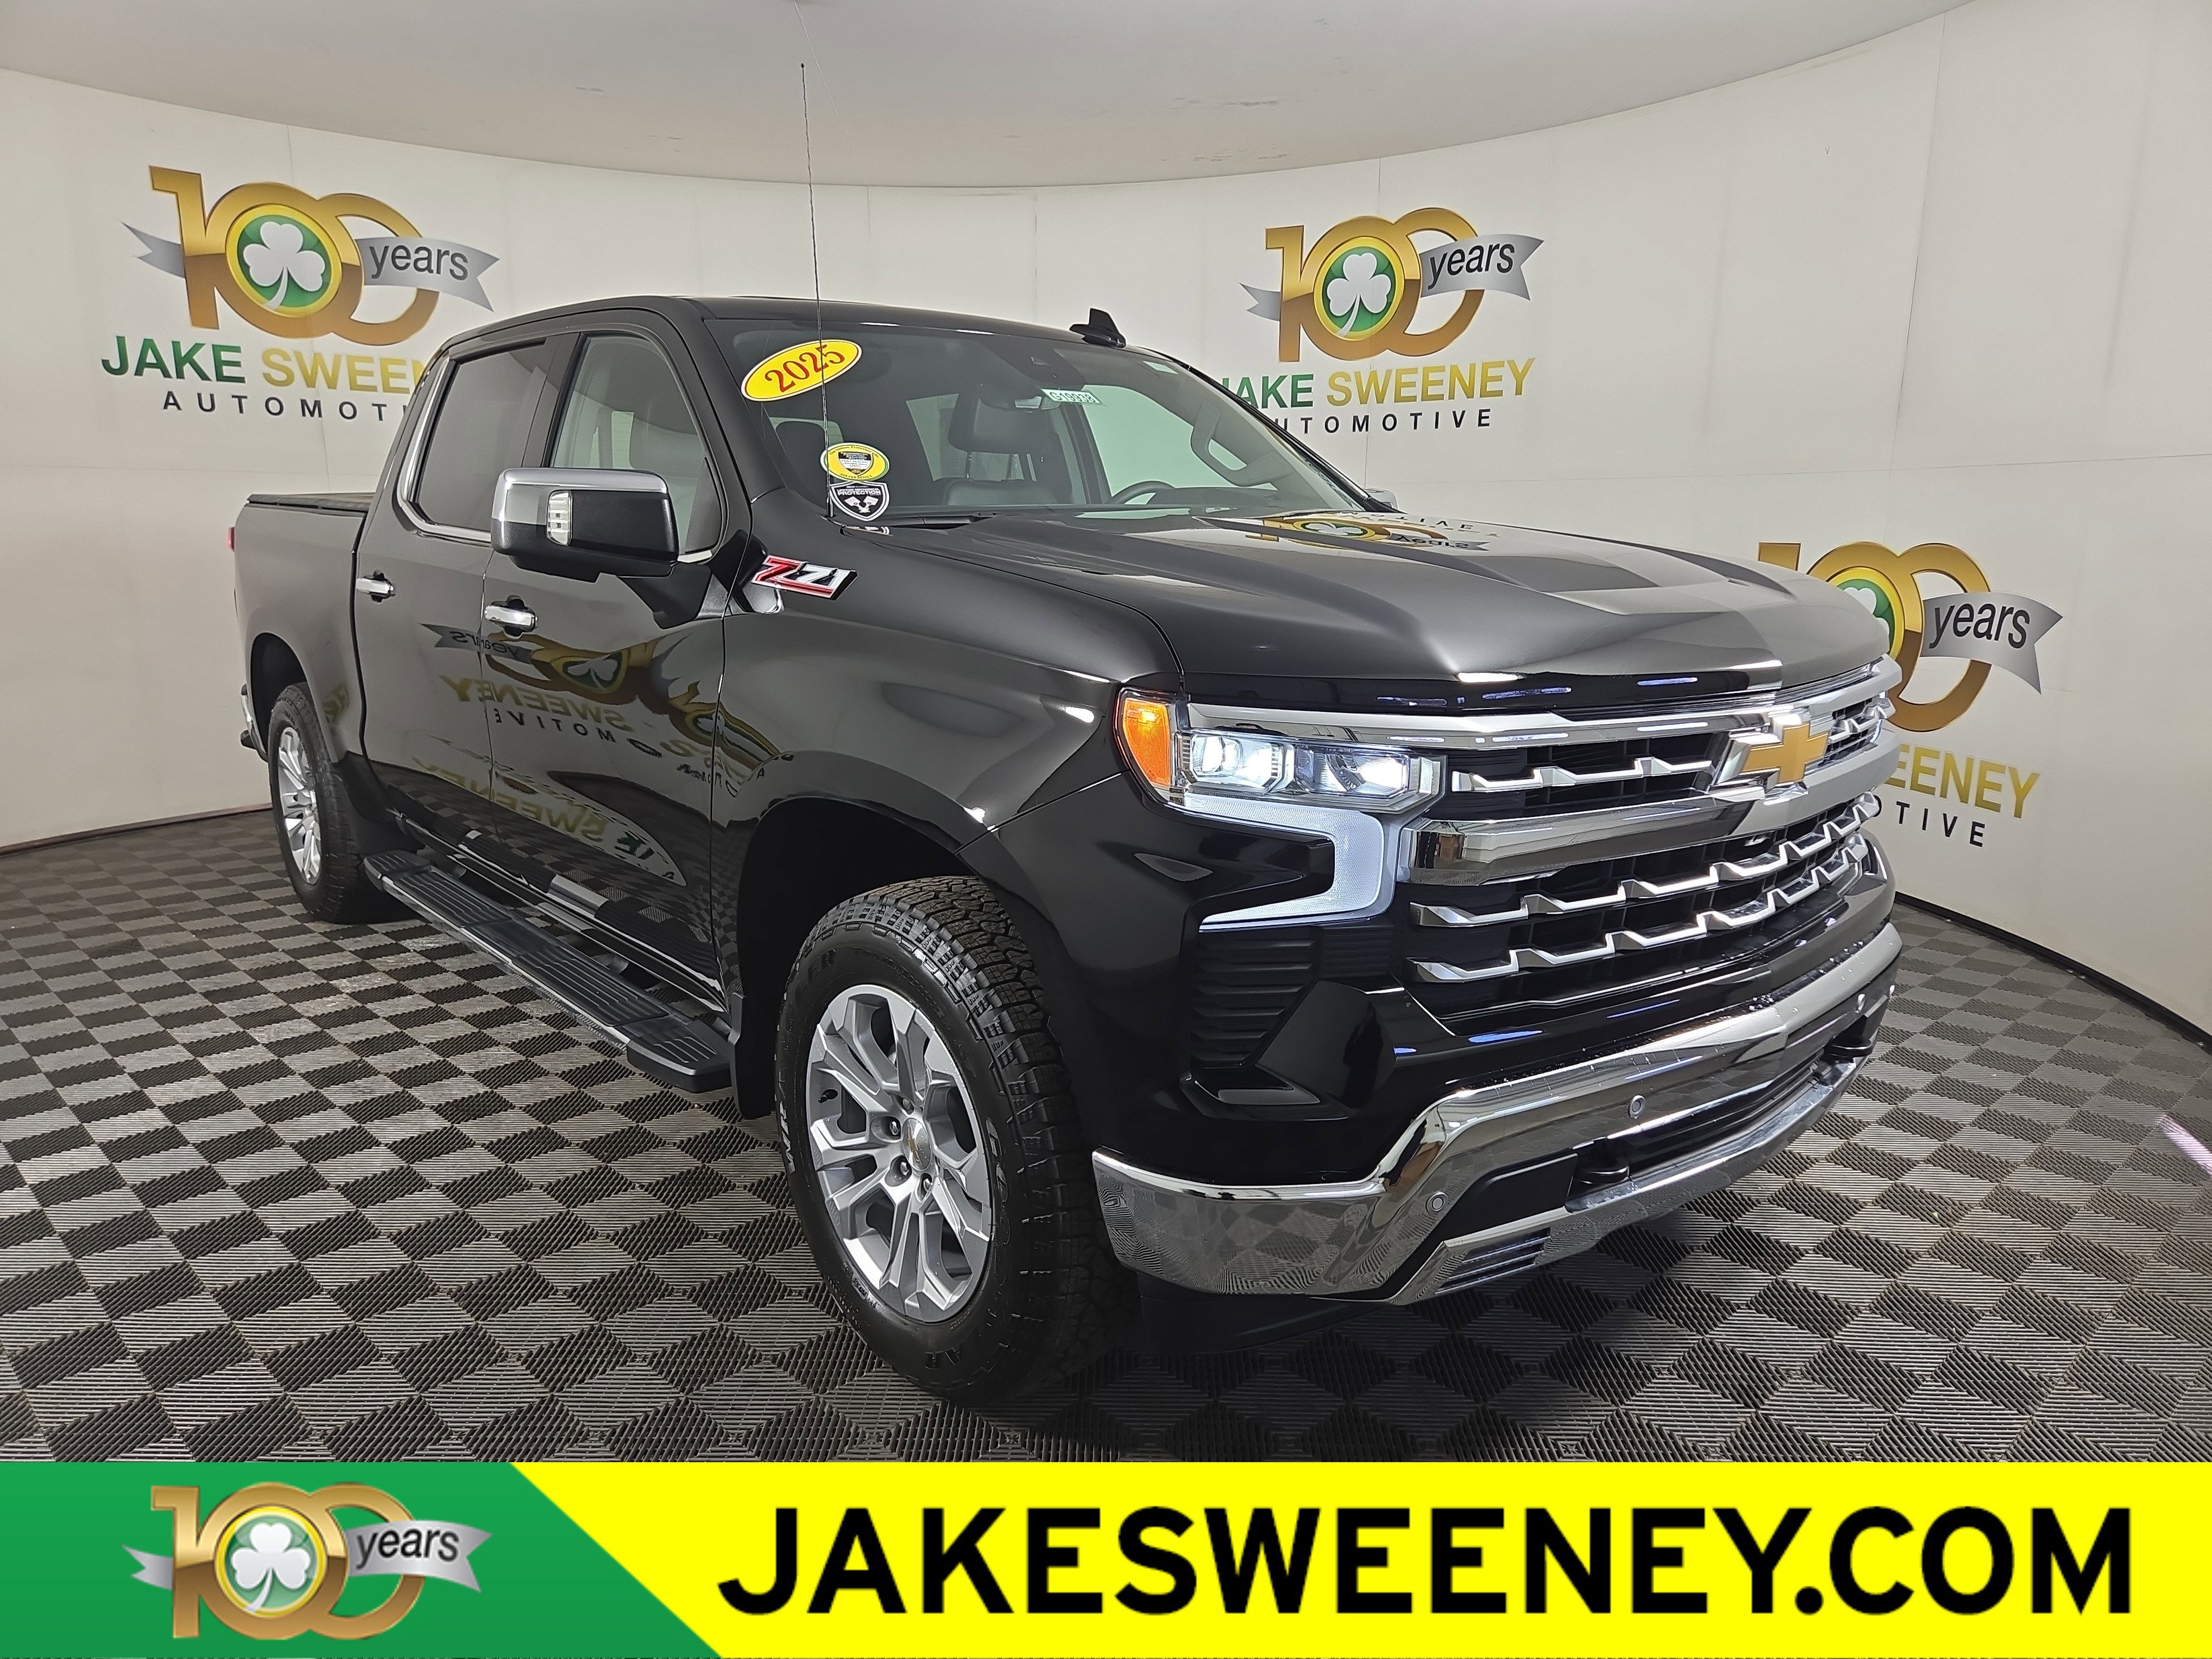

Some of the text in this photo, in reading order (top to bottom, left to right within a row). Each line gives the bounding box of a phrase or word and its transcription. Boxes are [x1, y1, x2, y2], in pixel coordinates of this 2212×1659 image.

[370, 243, 470, 281] years
[1427, 242, 1515, 290] years
[101, 335, 246, 384] JAKE
[764, 344, 846, 393] 2025
[1223, 358, 1536, 409] AKE SWEENEY
[1050, 392, 1096, 402] G19938
[751, 554, 855, 600] Z71
[1928, 602, 2030, 650] years
